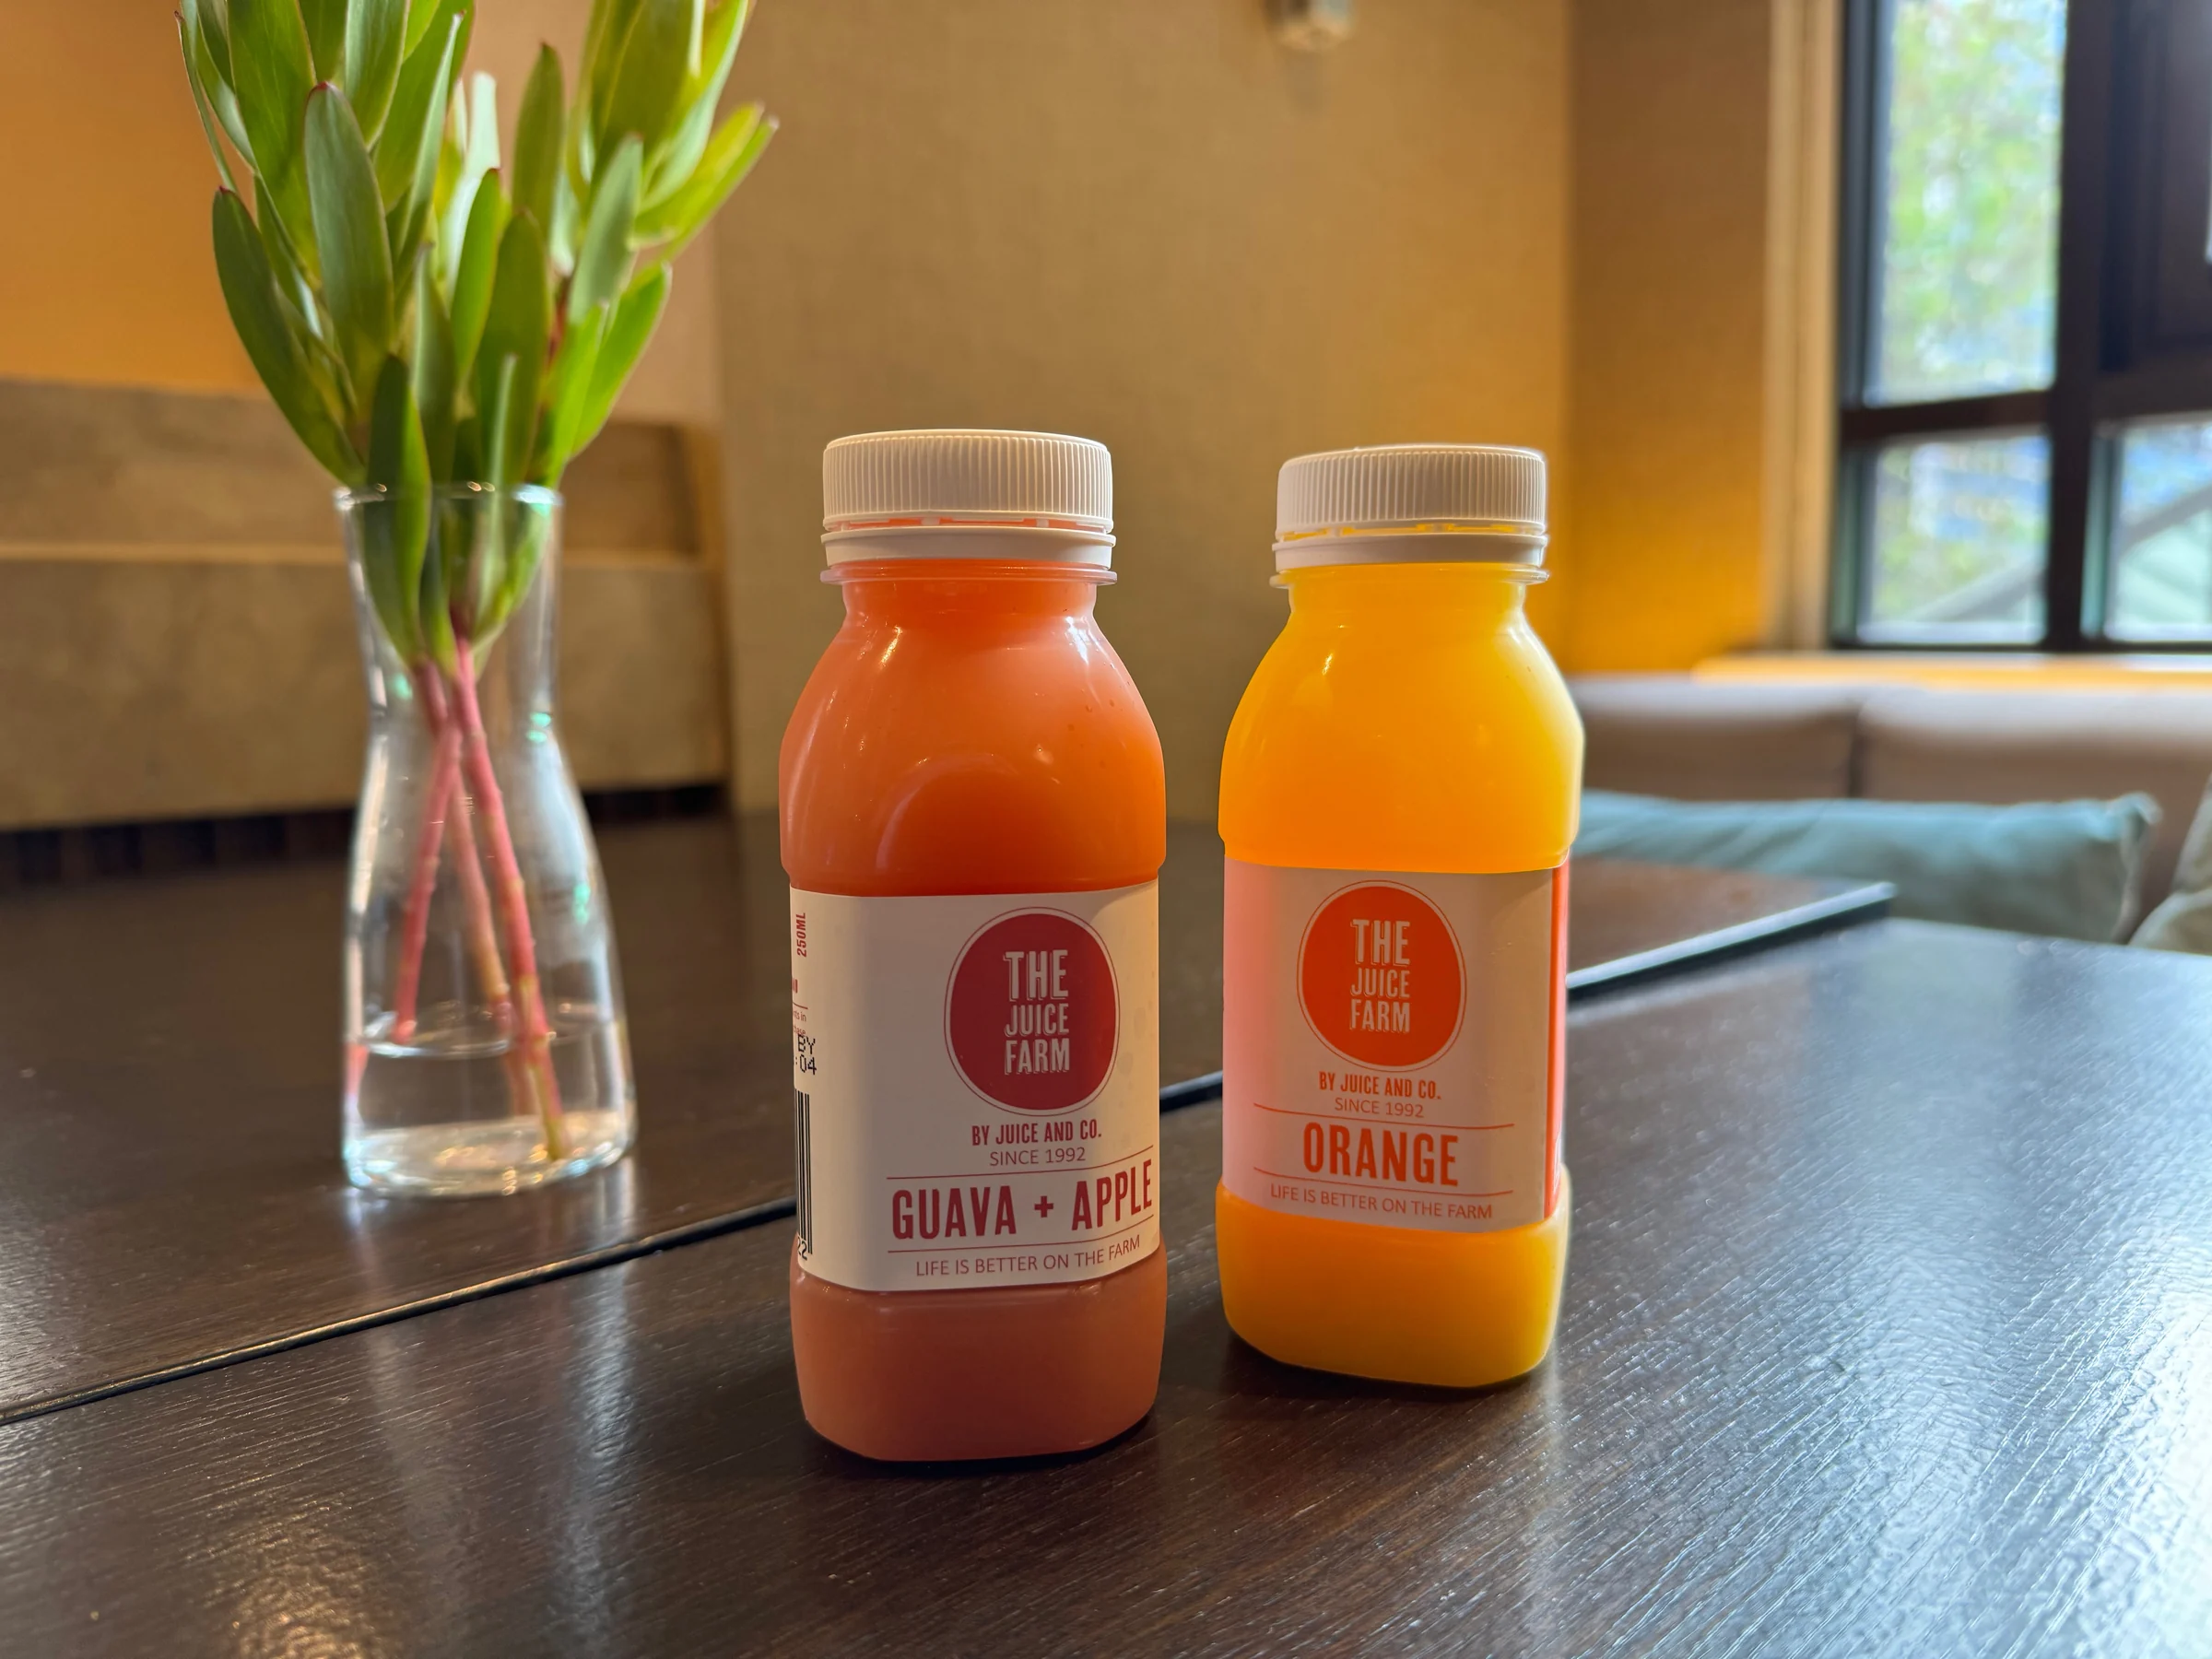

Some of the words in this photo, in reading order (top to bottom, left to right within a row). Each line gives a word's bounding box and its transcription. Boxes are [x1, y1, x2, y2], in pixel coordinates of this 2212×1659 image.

[796, 912, 807, 958] 250ML
[1351, 919, 1410, 966] THE
[1003, 949, 1069, 1002] THE
[1350, 968, 1410, 999] JUICE
[1004, 1003, 1069, 1037] JUICE
[1349, 998, 1410, 1033] FARM
[797, 1033, 816, 1055] BY
[1004, 1038, 1070, 1075] FARM
[1319, 1071, 1335, 1091] BY
[1340, 1074, 1380, 1095] JUICE
[1384, 1077, 1413, 1099] AND
[1418, 1079, 1441, 1100] CO.
[1335, 1097, 1380, 1114] SINCE
[1385, 1102, 1425, 1119] 1992
[971, 1124, 990, 1147] BY
[995, 1123, 1039, 1146] JUICE
[1043, 1120, 1074, 1143] AND
[1079, 1118, 1102, 1140] CO.
[989, 1149, 1040, 1167] SINCE
[1045, 1147, 1087, 1164] 1992
[1303, 1122, 1459, 1188] ORANGE
[892, 1185, 1018, 1241] GUAVA
[1071, 1159, 1153, 1231] APPLE
[1270, 1183, 1300, 1202] LIFE
[1303, 1189, 1317, 1204] IS
[1321, 1191, 1378, 1212] BETTER
[1382, 1197, 1406, 1215] ON
[1410, 1200, 1443, 1218] THE
[1447, 1204, 1493, 1220] FARM
[915, 1261, 950, 1277] LIFE
[955, 1259, 970, 1276] IS
[975, 1254, 1039, 1275] BETTER
[1042, 1253, 1070, 1271] ON
[1074, 1248, 1105, 1268] THE
[1109, 1233, 1141, 1262] FARM
